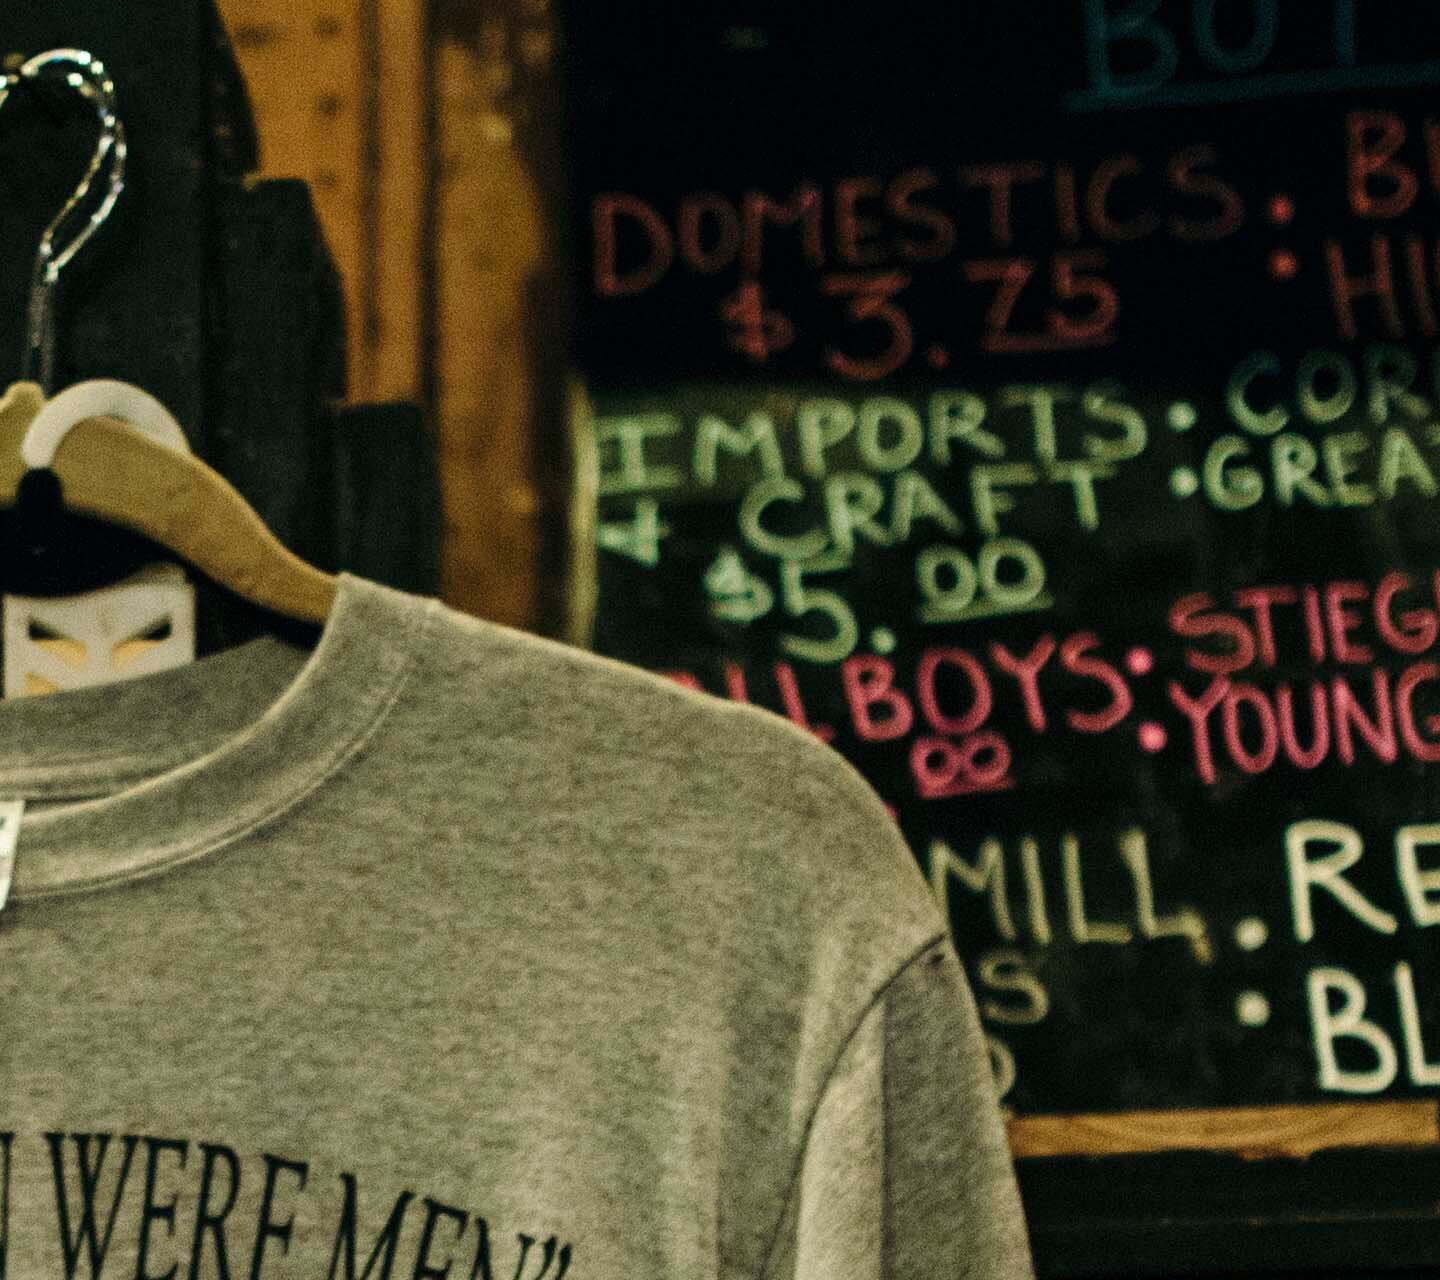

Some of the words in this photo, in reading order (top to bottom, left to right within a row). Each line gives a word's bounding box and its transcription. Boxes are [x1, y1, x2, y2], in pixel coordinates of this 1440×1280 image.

[590, 145, 1248, 298] DOMESTICS
[596, 384, 1149, 495] IMPORTS
[738, 460, 1116, 563] CRAFT
